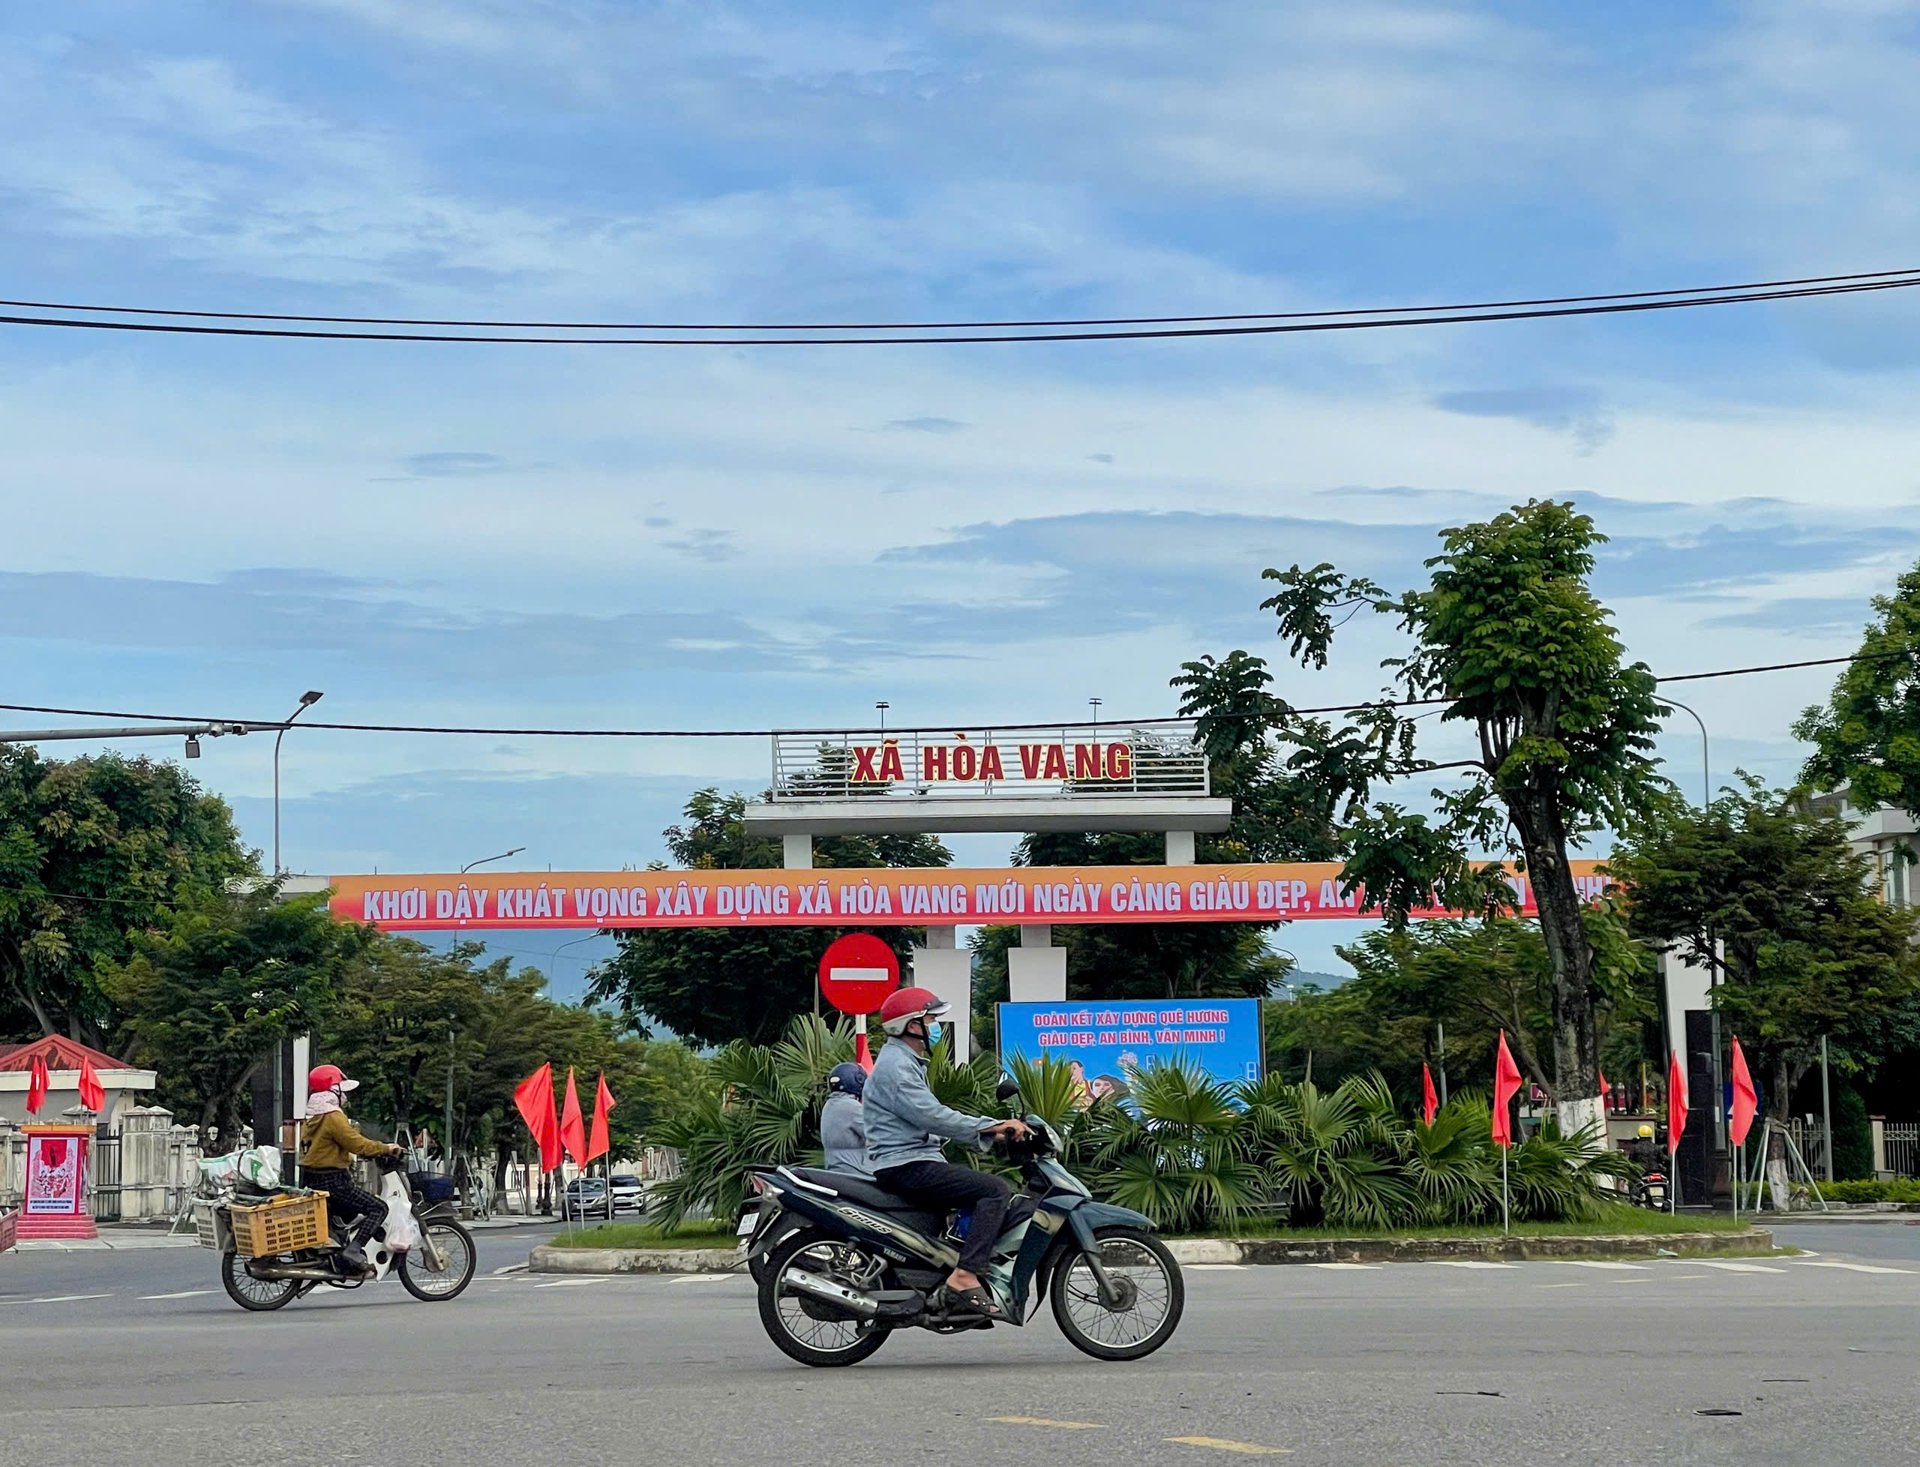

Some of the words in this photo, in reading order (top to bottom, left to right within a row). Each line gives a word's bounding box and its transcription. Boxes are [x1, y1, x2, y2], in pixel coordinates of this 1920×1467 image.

[850, 738, 905, 783] XÃ
[921, 732, 1006, 782] HÒA
[1017, 742, 1133, 781] VANG
[363, 887, 427, 920] KHƠI
[436, 882, 489, 925] DẬY
[497, 882, 567, 918] KHÁT
[574, 886, 647, 923] VỌNG
[655, 880, 708, 916] XÂY
[716, 882, 789, 921] DỰNG
[797, 879, 833, 914] XÃ
[840, 878, 892, 914] HÒA
[900, 884, 967, 914] VANG
[975, 878, 1025, 914] MỚI
[1033, 877, 1102, 913] NGÀY
[1111, 876, 1181, 912] CÀNG
[1190, 875, 1249, 911] GIÀU
[1257, 880, 1310, 916] ĐẸP,
[1033, 1011, 1068, 1027] ĐOÀN
[1070, 1009, 1093, 1026] KẾT
[1096, 1010, 1120, 1026] XÂY
[1123, 1011, 1156, 1027] DỰNG
[1160, 1008, 1183, 1025] QUÊ
[1186, 1010, 1229, 1024] HƯƠNG
[1039, 1031, 1068, 1047] GIÀU
[1099, 1032, 1118, 1045] AN
[1120, 1029, 1153, 1045] BÌNH,
[1184, 1030, 1217, 1043] MINH
[883, 1247, 907, 1263] YAMAHA
